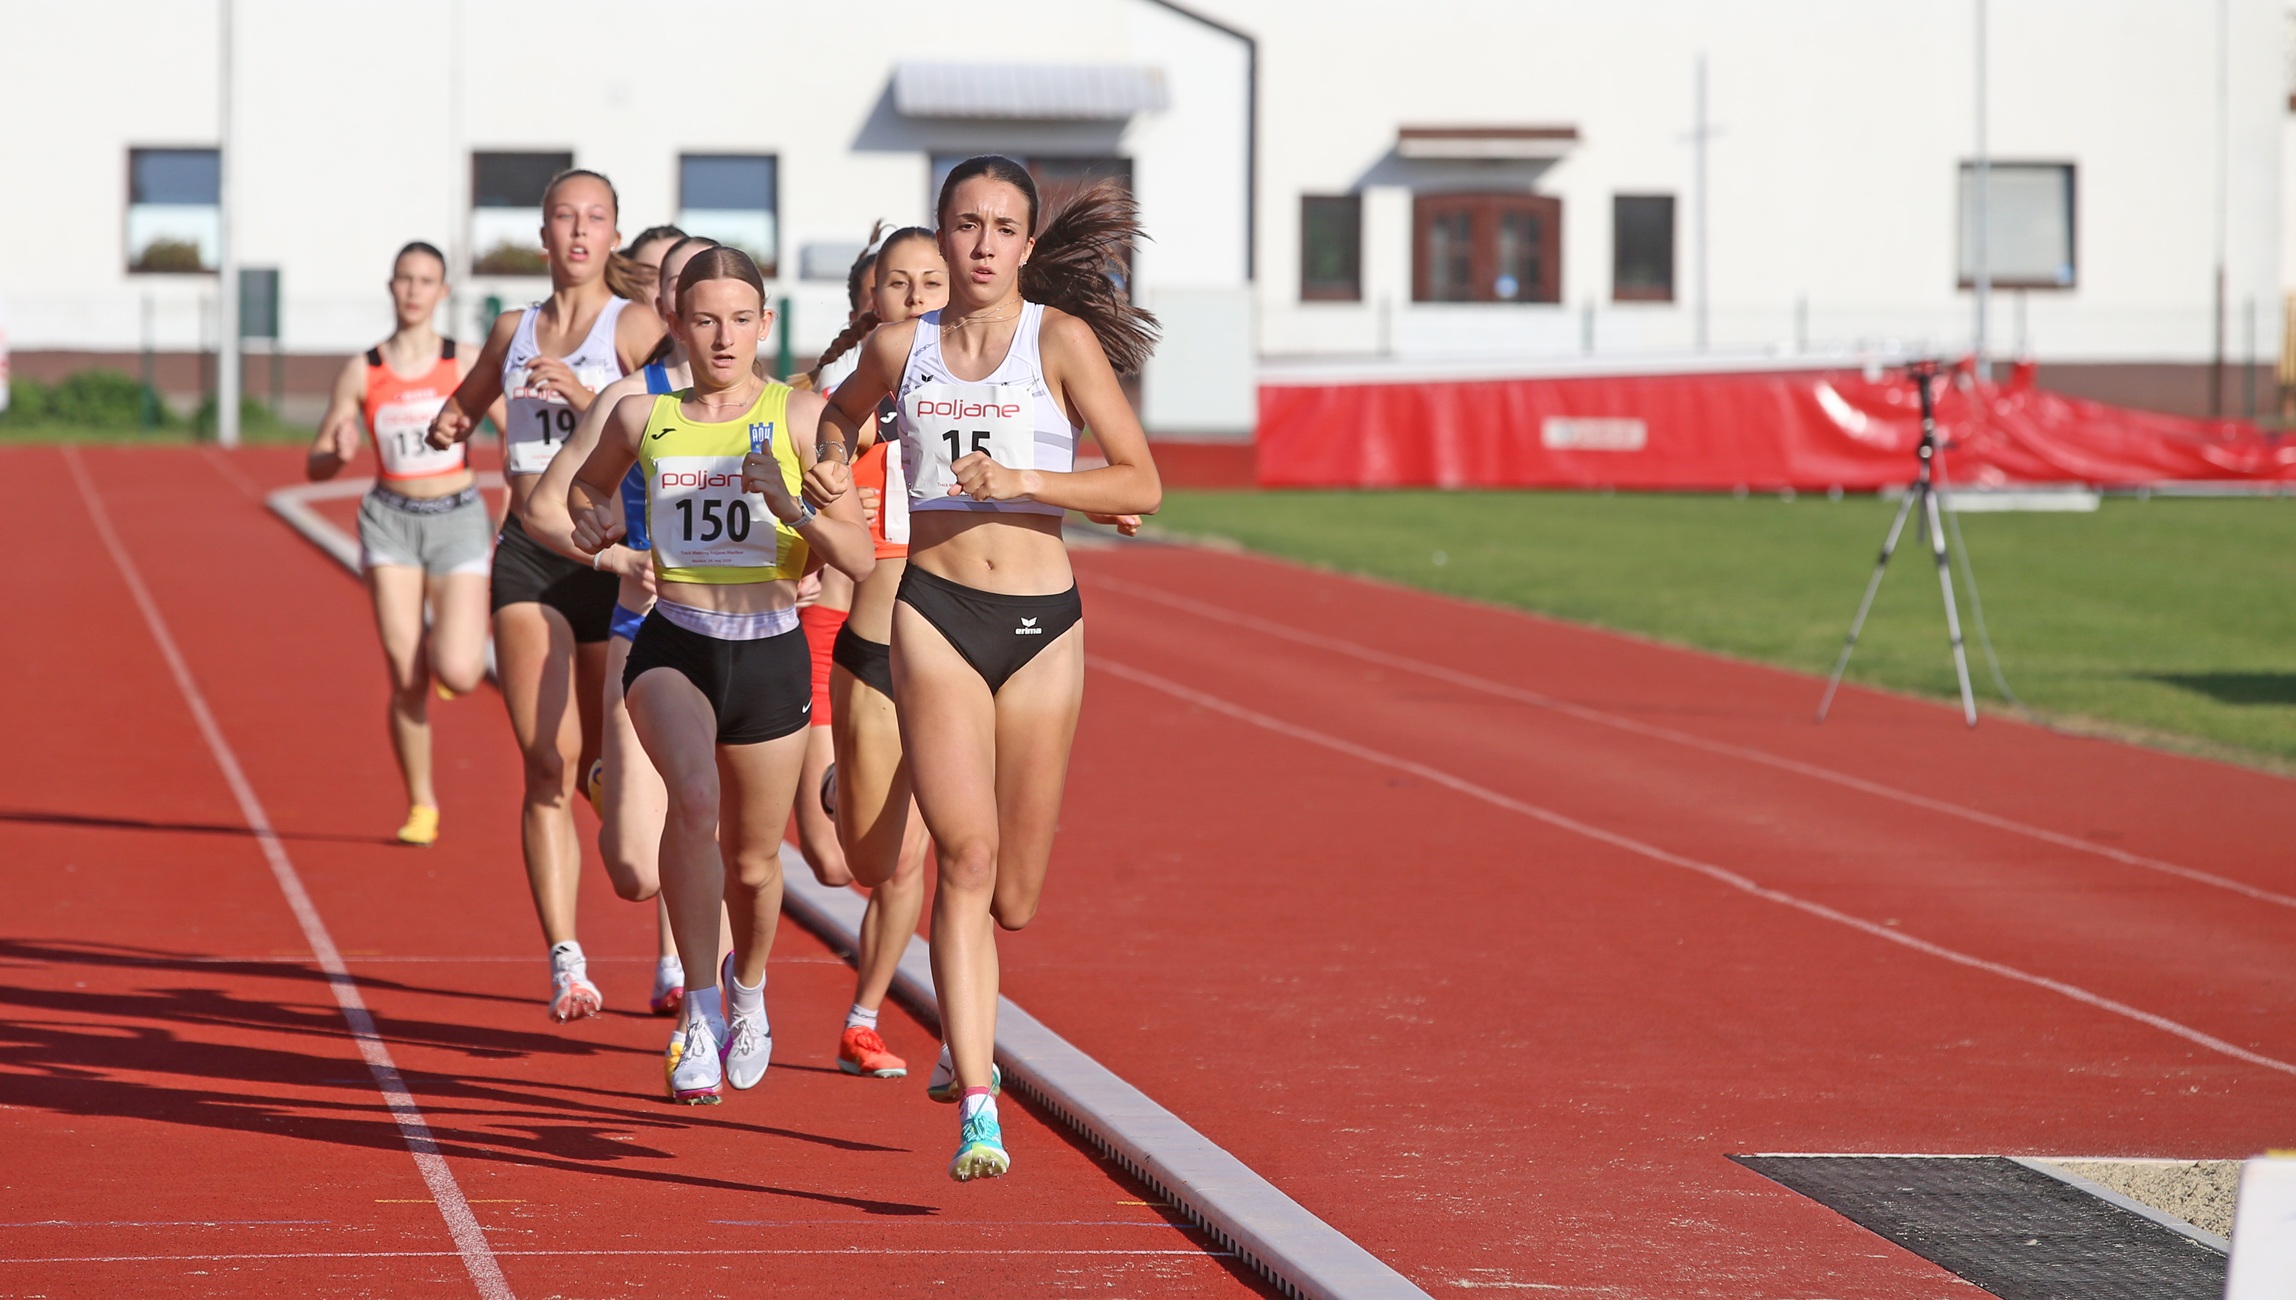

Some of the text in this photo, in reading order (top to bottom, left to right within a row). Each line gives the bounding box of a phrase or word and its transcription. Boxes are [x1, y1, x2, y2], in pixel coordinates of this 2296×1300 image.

[917, 399, 1020, 420] poljane
[535, 408, 576, 445] 19
[942, 429, 992, 466] 15
[661, 470, 744, 490] poljan
[675, 498, 750, 543] 150
[1015, 627, 1042, 635] erima
